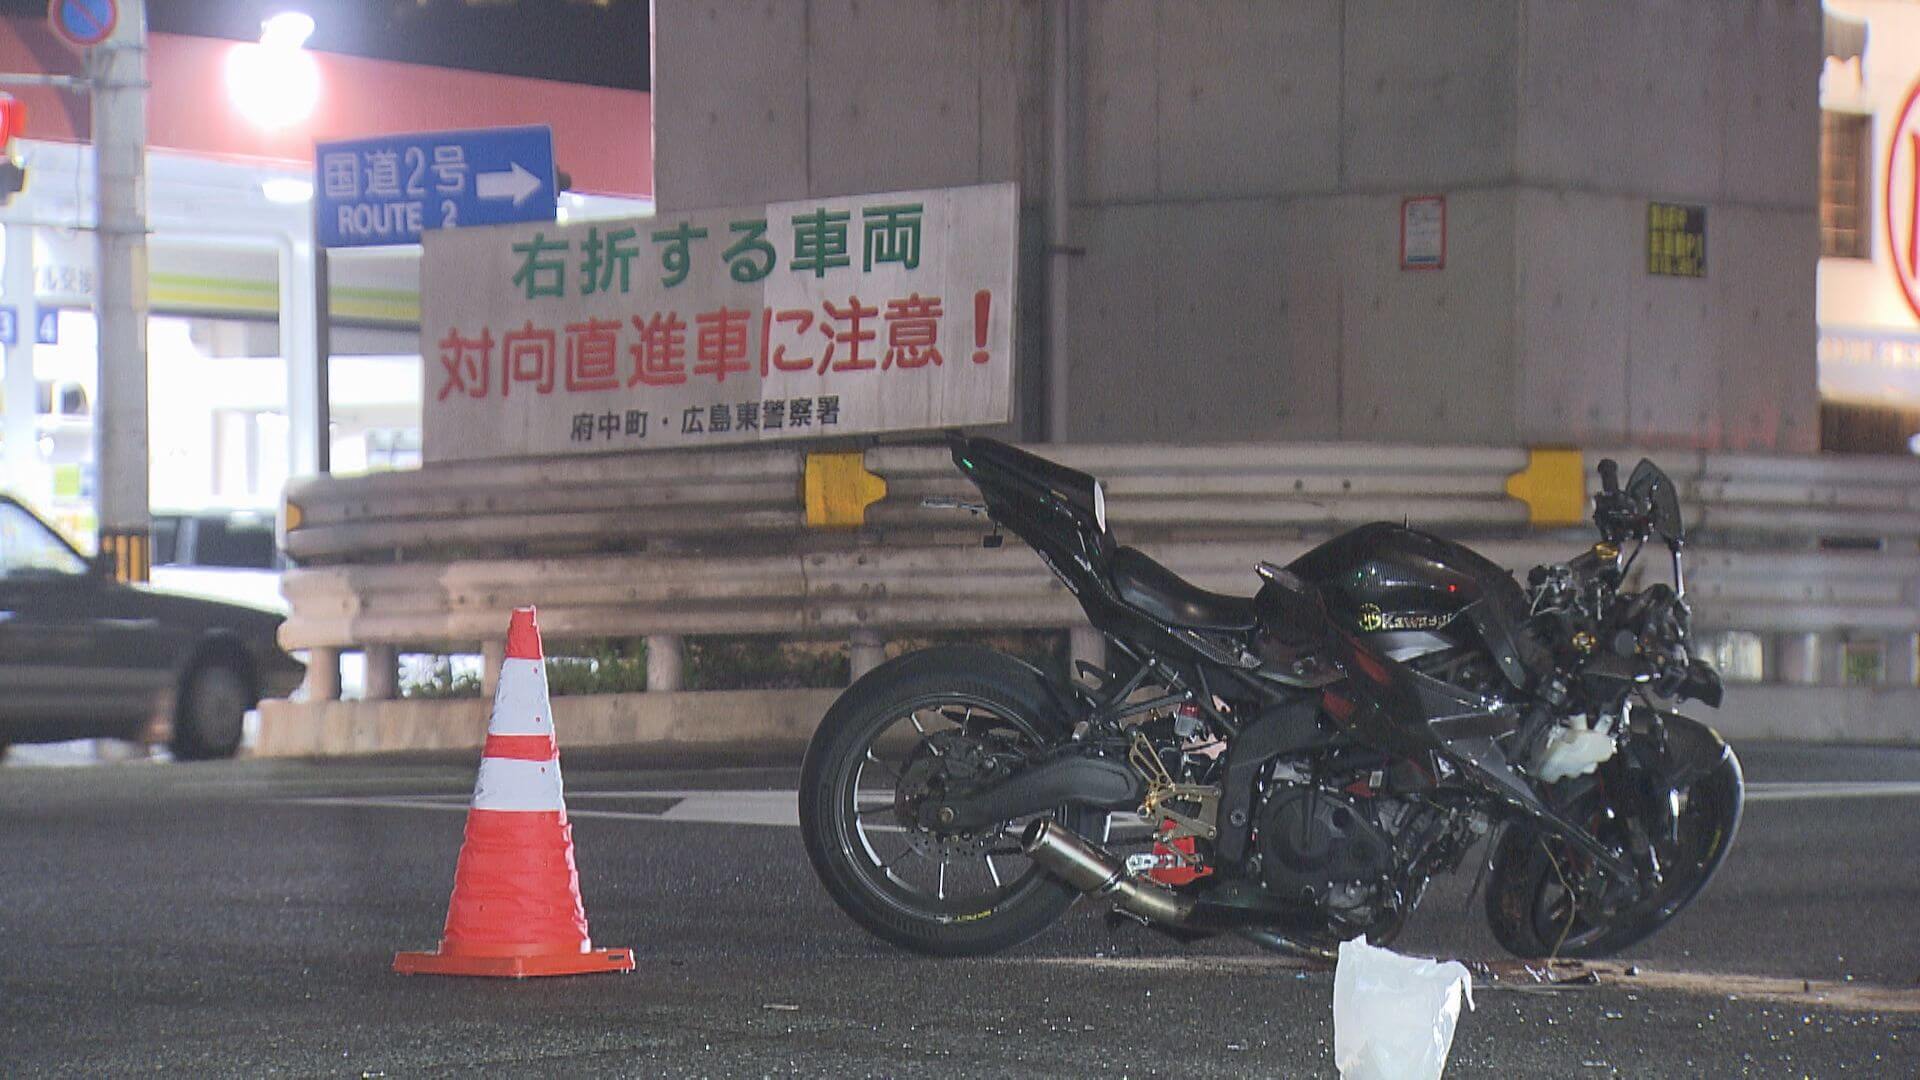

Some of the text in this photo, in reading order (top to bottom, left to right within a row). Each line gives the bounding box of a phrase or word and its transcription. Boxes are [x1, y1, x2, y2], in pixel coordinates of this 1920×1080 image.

[323, 145, 468, 197] 国道2号
[338, 199, 457, 234] ROUTE 2
[512, 203, 924, 300] 右折する車両
[39, 312, 56, 342] 4
[570, 395, 840, 441] 府中町・広島東警察署
[1381, 612, 1453, 630] Kawasa
